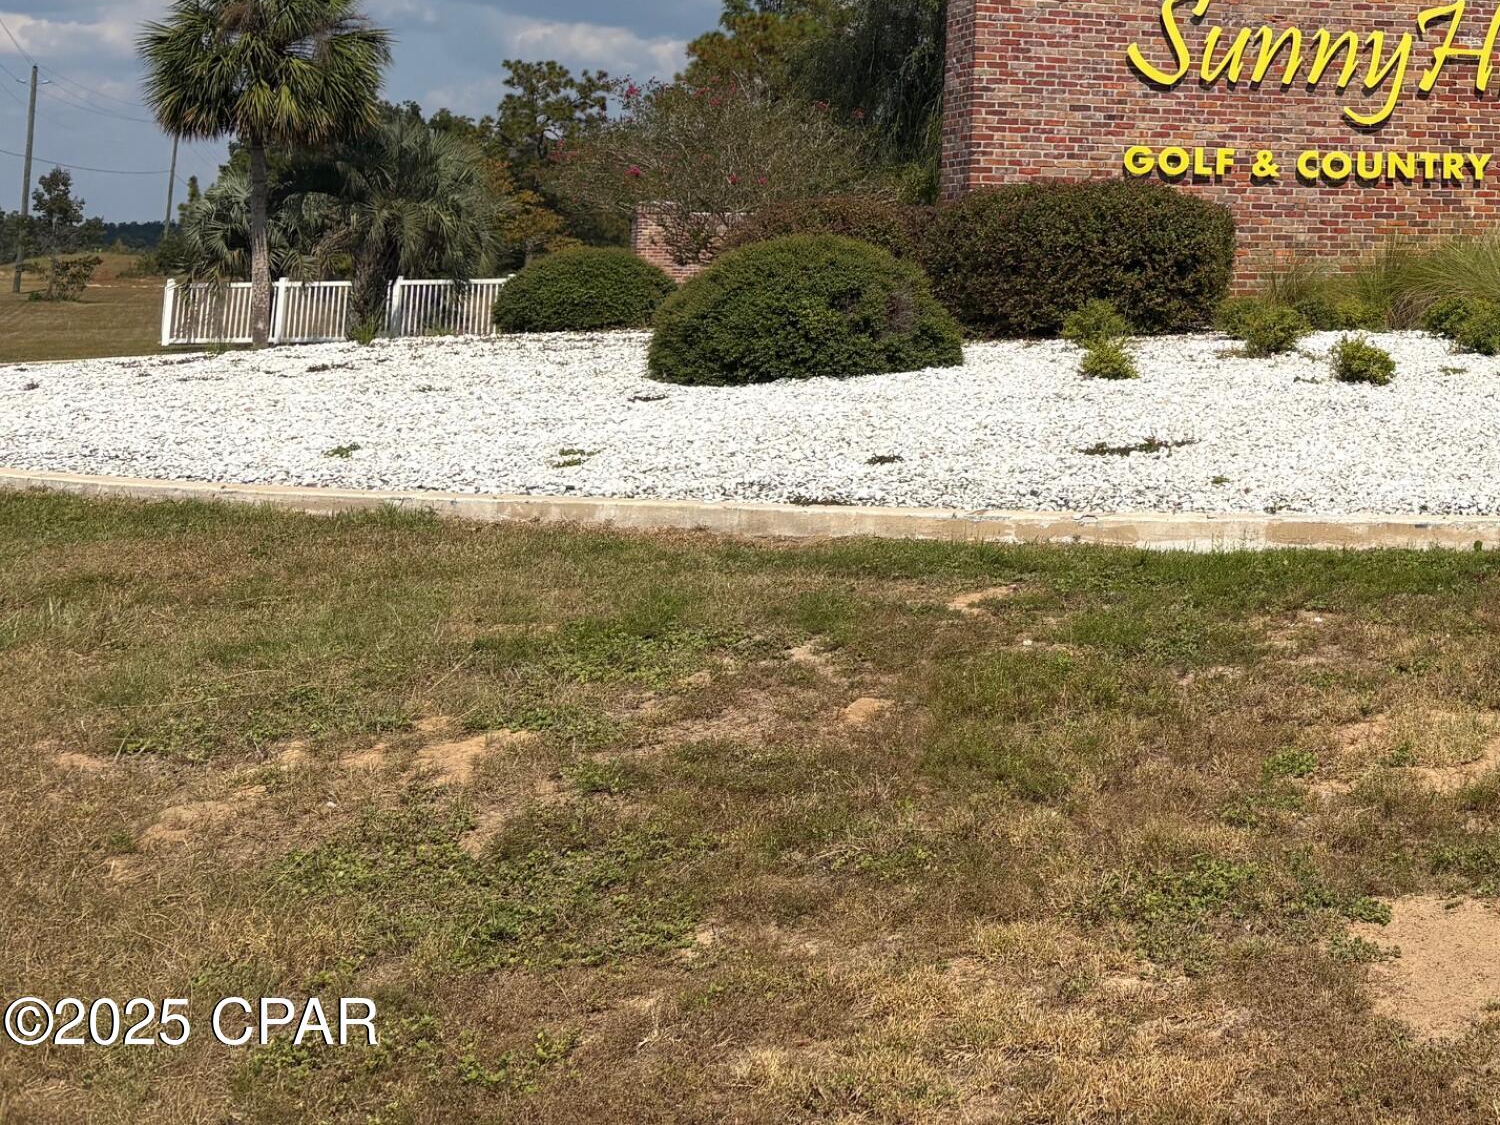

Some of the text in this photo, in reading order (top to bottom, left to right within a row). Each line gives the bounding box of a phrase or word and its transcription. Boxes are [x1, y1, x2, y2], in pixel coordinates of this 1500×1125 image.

[1122, 144, 1236, 177] GOLF
[1251, 149, 1280, 179] &
[1295, 149, 1492, 182] COUNTRY
